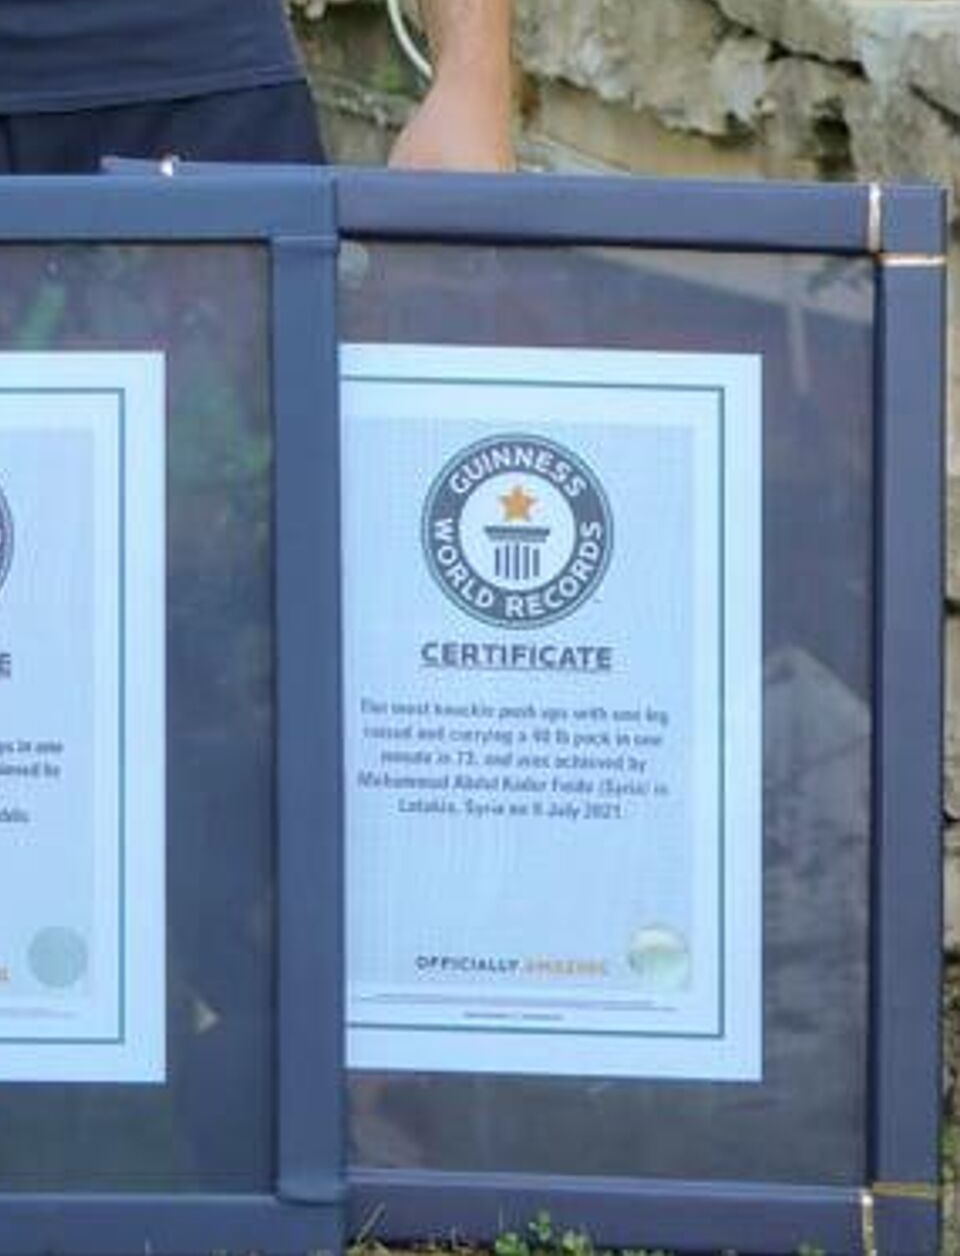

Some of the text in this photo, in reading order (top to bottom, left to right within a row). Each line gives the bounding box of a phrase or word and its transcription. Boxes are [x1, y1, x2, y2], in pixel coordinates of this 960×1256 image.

[448, 445, 588, 497] GUINNESS
[434, 517, 602, 618] WORLD RECORDS
[420, 642, 614, 670] CERTIFICATE
[391, 701, 429, 716] most
[498, 704, 537, 722] push
[541, 708, 568, 724] ups
[572, 706, 608, 721] with
[417, 726, 446, 741] and
[449, 728, 514, 746] carrying
[573, 731, 610, 749] pack
[484, 753, 514, 767] and
[554, 754, 624, 772] achieved
[627, 755, 648, 774] by
[465, 799, 505, 819] Syria
[546, 801, 581, 821] July
[414, 955, 521, 974] OFFICIALLY
